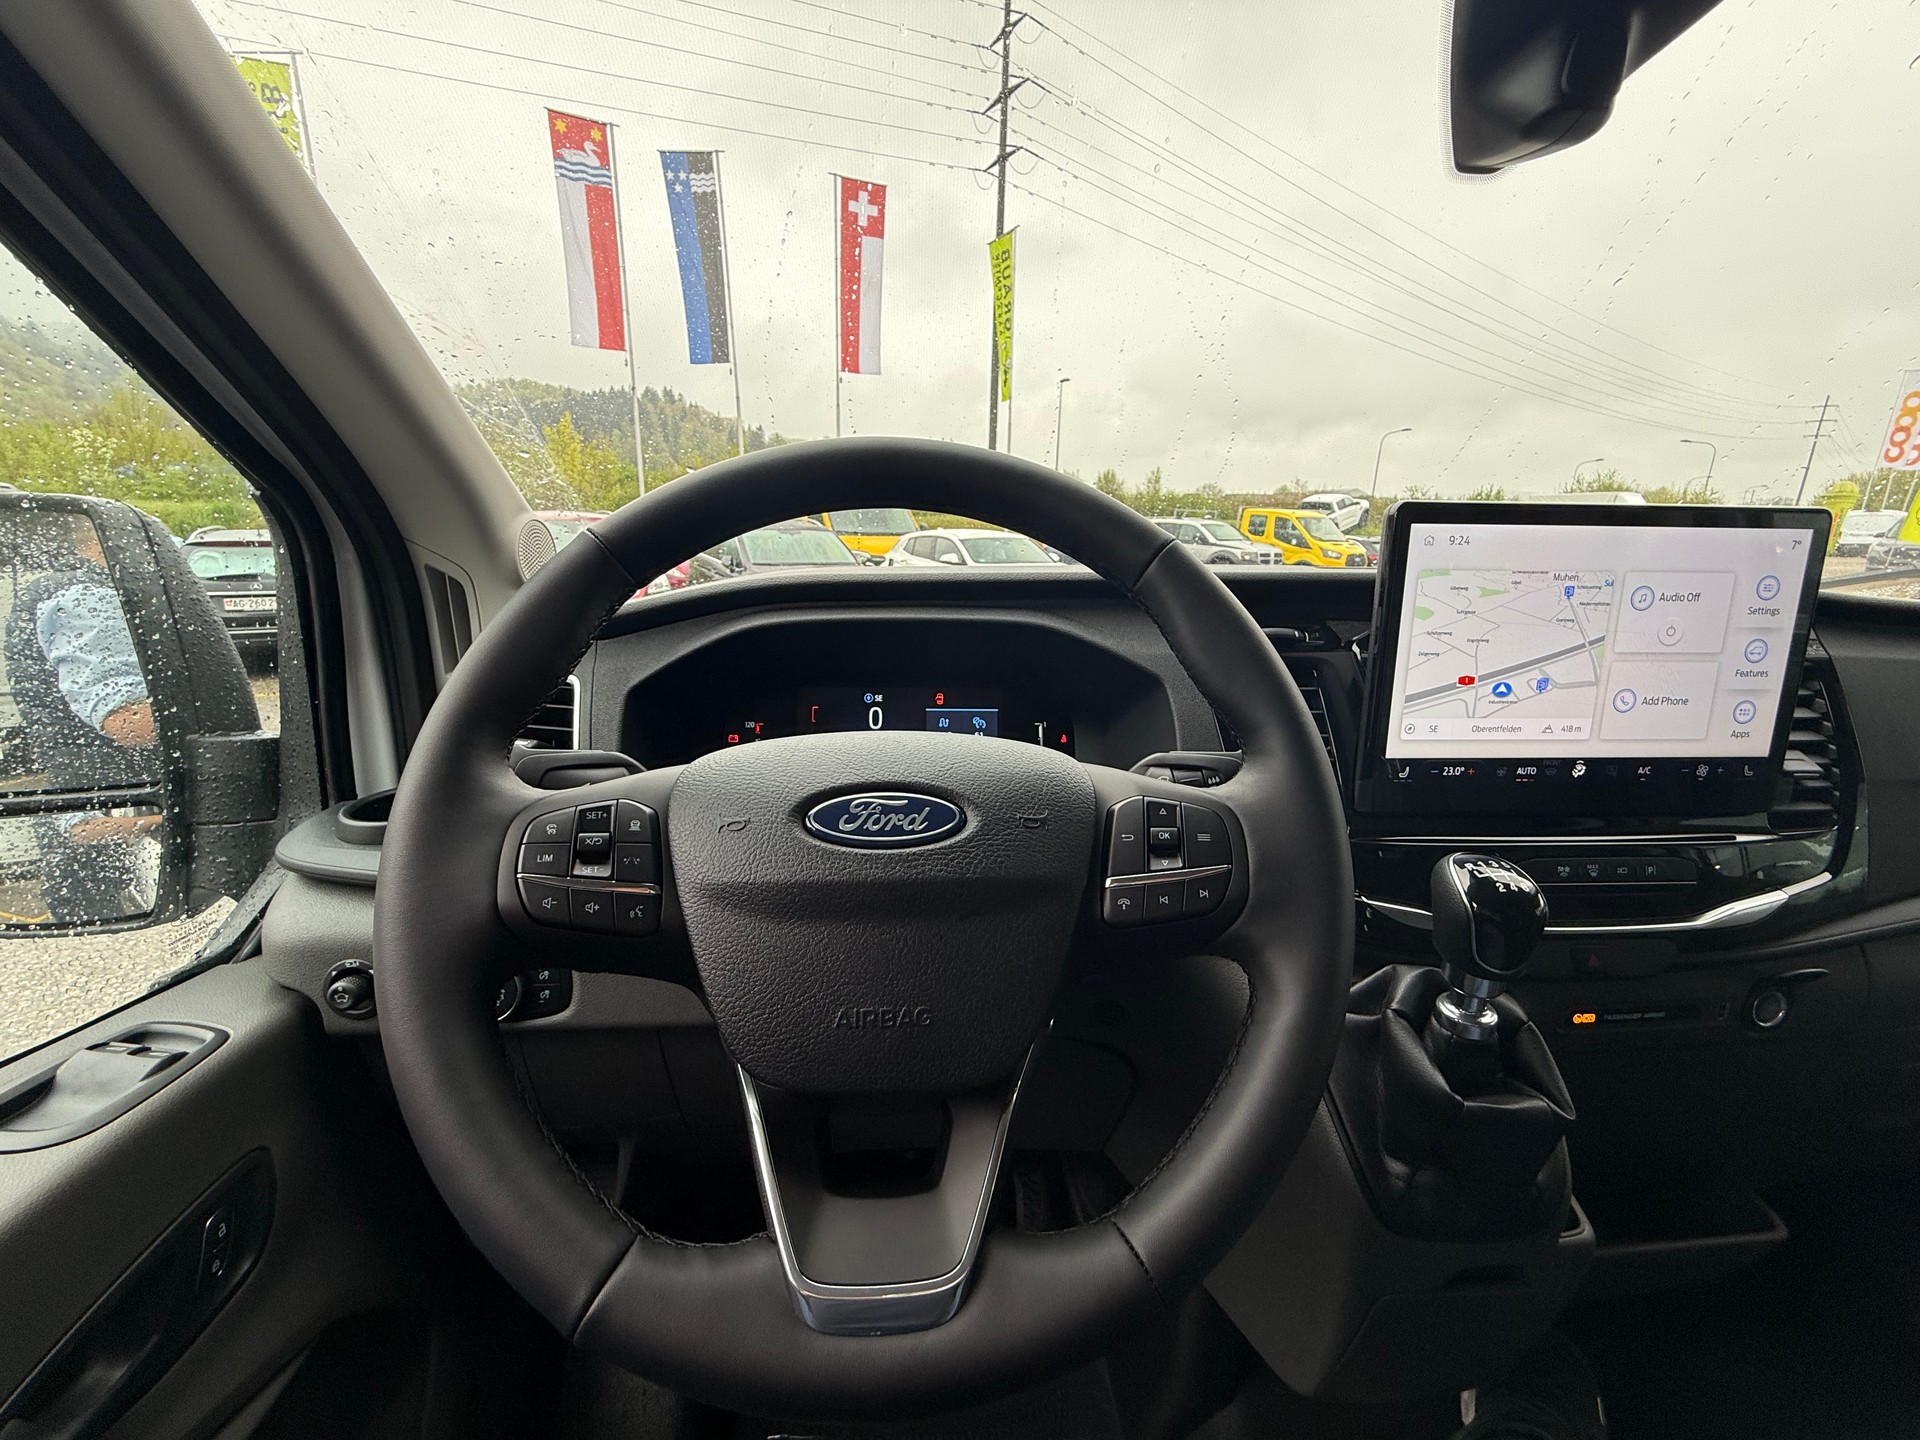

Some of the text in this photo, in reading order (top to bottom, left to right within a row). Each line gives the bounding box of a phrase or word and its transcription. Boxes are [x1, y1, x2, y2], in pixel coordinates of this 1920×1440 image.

[1449, 535, 1470, 546] 9:24
[1553, 573, 1579, 582] Muhen
[1659, 593, 1701, 603] Audio Off
[1747, 606, 1780, 617] Settings
[1735, 669, 1769, 678] Features
[874, 694, 883, 702] SE
[1641, 696, 1689, 706] Add Phone
[868, 706, 883, 730] 0
[1428, 725, 1438, 733] SE
[1471, 724, 1522, 733] Oberentfelden
[1561, 725, 1573, 733] 418
[1730, 730, 1750, 739] Apps
[1516, 767, 1537, 775] AUTO
[1637, 766, 1651, 774] A/C
[838, 798, 931, 832] Ford
[1158, 831, 1171, 840] OK
[537, 854, 553, 862] LIM
[1464, 862, 1476, 871] R
[1495, 882, 1507, 893] 2
[1510, 882, 1519, 892] 4
[833, 1005, 933, 1028] AIRBAG
